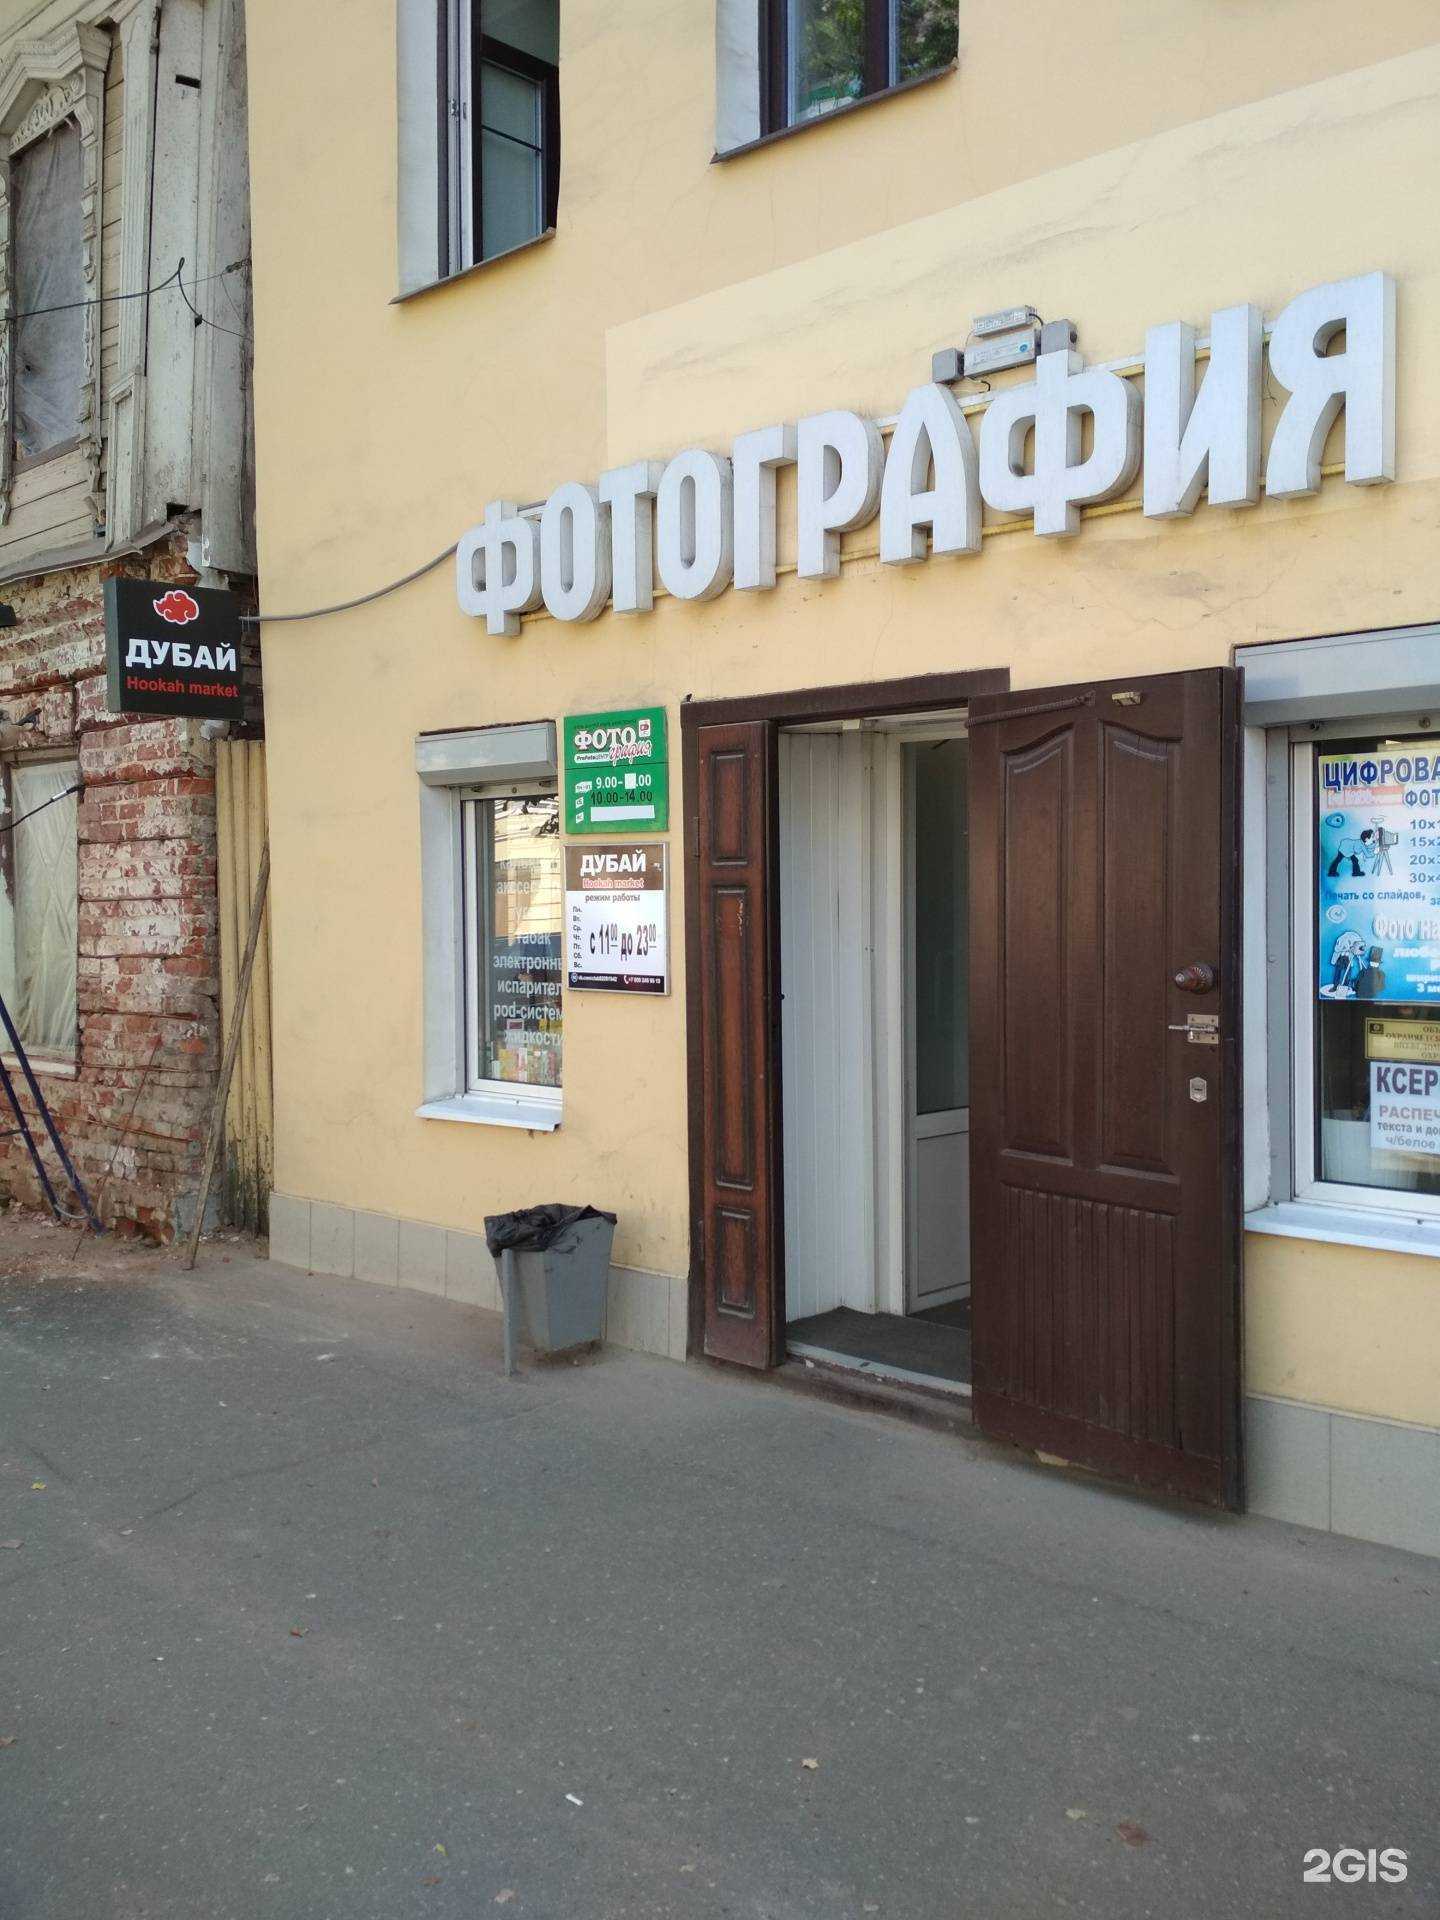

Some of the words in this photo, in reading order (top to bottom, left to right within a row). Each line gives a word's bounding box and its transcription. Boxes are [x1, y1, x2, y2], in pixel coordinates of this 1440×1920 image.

[456, 271, 1396, 636] ФОТОГРАФИЯ
[125, 638, 237, 671] ДУБАЙ
[127, 676, 185, 694] Hookah
[189, 682, 239, 698] market
[574, 726, 636, 750] ФОТО
[580, 849, 647, 877] ДУБАЙ
[582, 877, 613, 888] Hookah
[614, 877, 644, 888] market
[585, 894, 610, 903] режим
[612, 892, 640, 903] работы
[1362, 891, 1374, 900] со
[620, 932, 634, 961] до
[1376, 1066, 1439, 1096] КСЕР
[1377, 1122, 1412, 1133] текста
[1416, 1126, 1422, 1134] и
